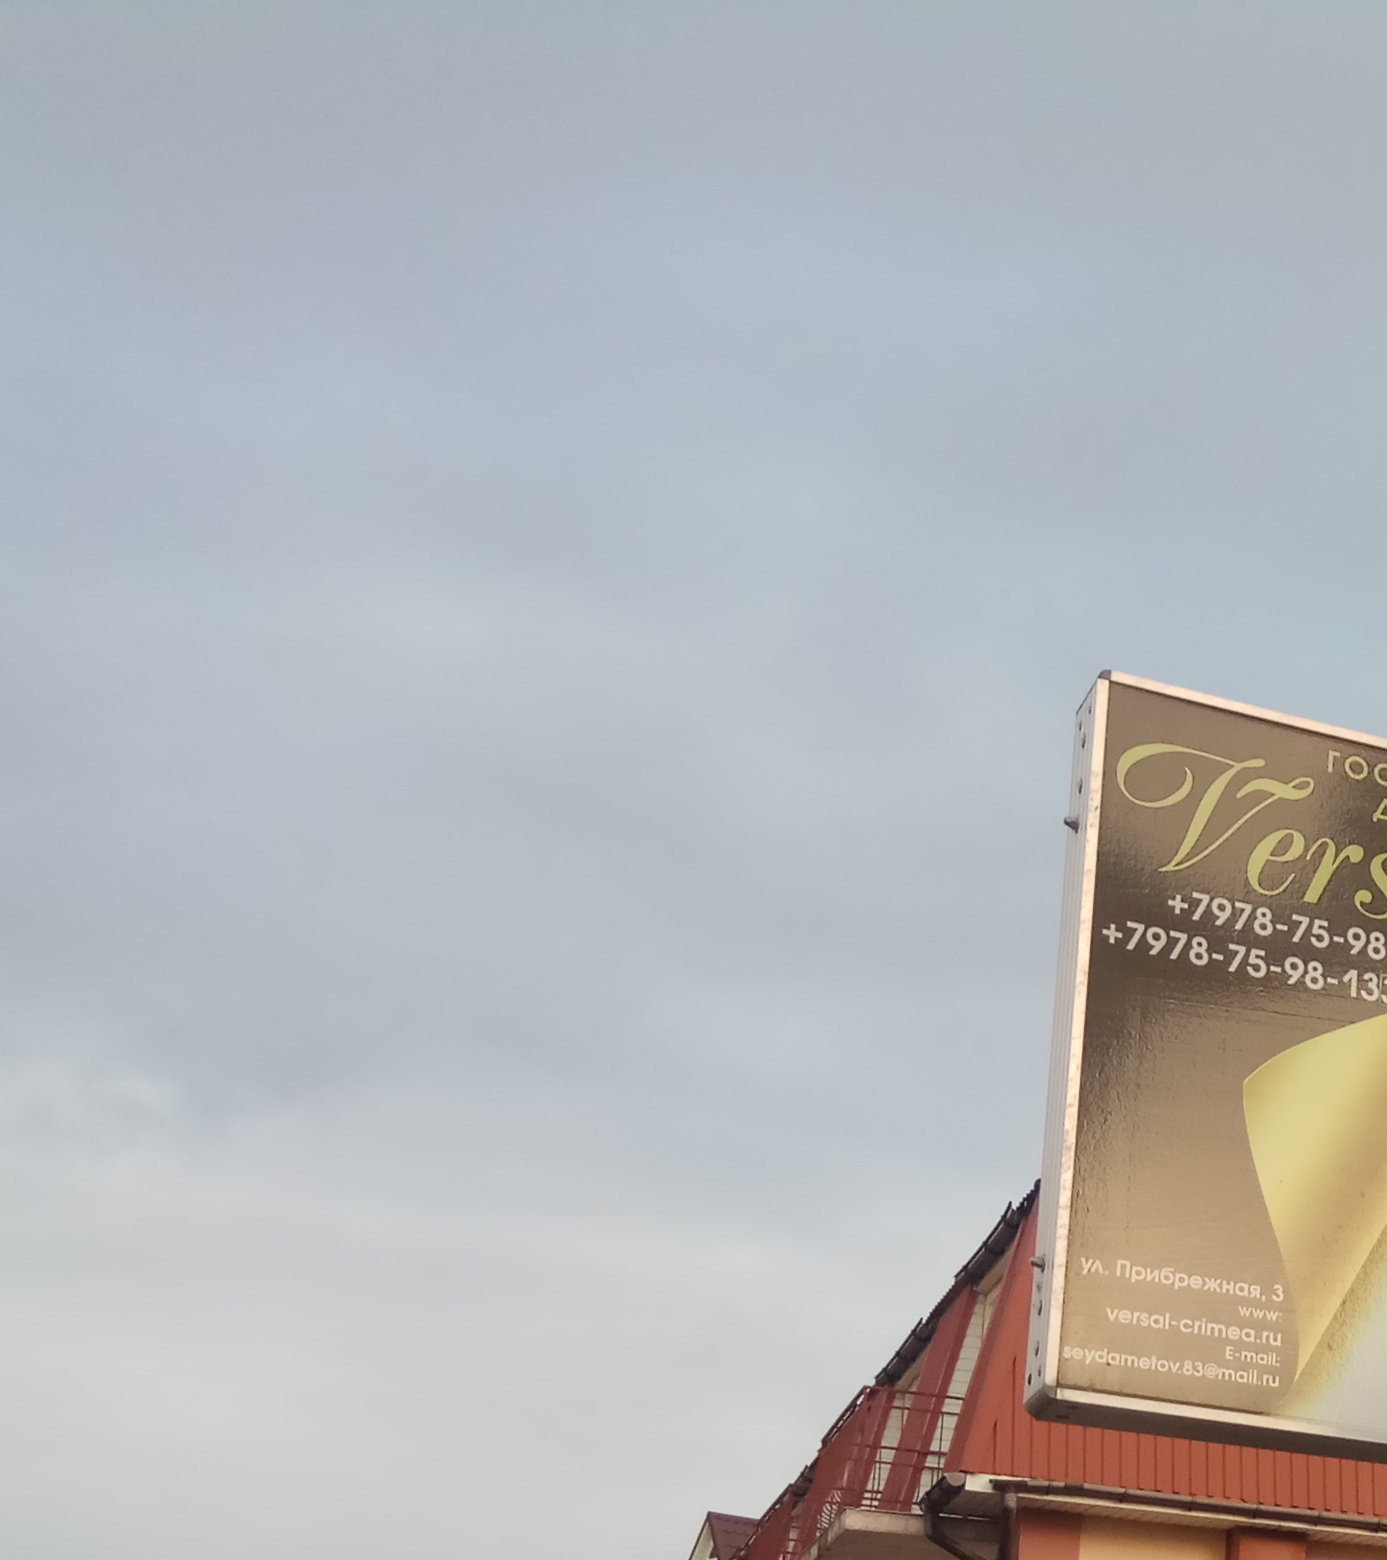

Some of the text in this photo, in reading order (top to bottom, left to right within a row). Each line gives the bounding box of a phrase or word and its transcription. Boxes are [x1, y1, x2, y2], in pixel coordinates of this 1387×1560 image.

[1080, 1256, 1284, 1302] ул. Прибрежная, 3
[1105, 1307, 1282, 1347] versal-crimea.ru
[1238, 1305, 1283, 1322] www:
[1062, 1344, 1280, 1388] seydametov.83@mail.ru
[1225, 1346, 1281, 1367] E-mail:
